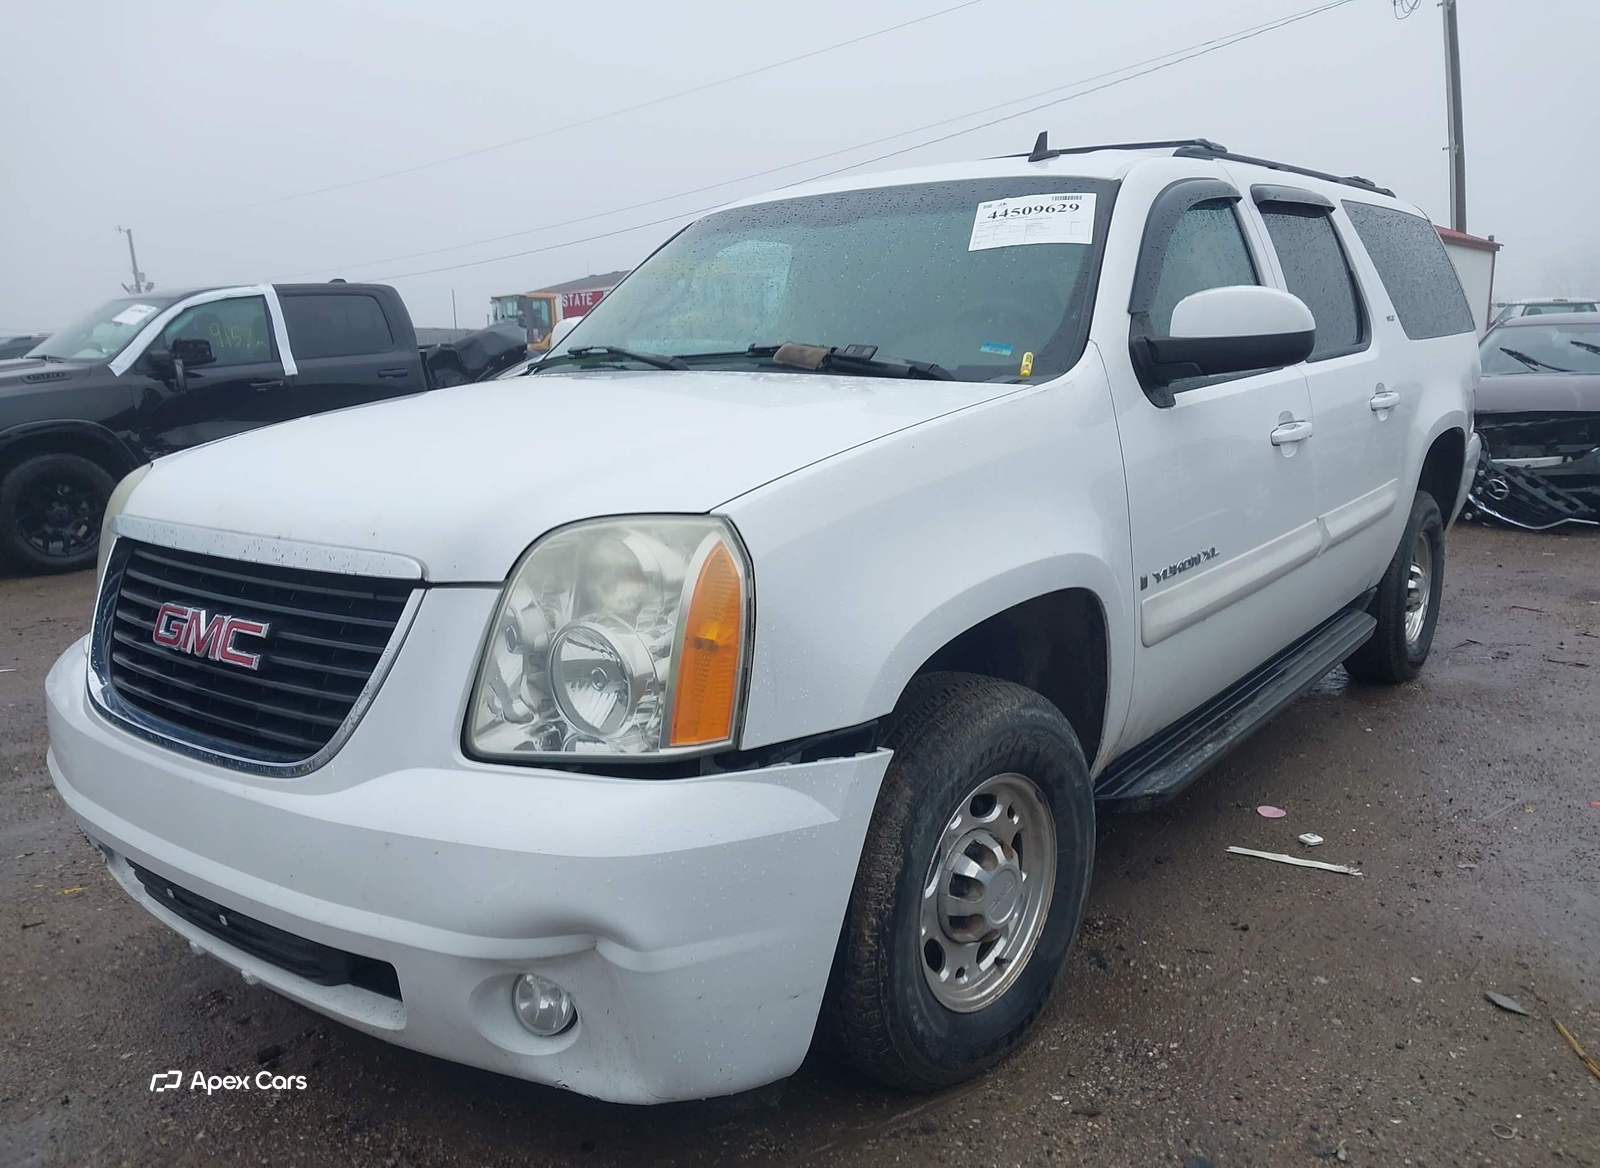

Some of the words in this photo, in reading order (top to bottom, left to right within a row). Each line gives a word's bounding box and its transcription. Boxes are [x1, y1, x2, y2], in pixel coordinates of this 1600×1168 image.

[987, 203, 1080, 220] 44509629
[562, 292, 593, 308] STATE
[1152, 552, 1201, 583] YUKON
[1201, 546, 1220, 562] XL
[153, 602, 272, 671] GMC
